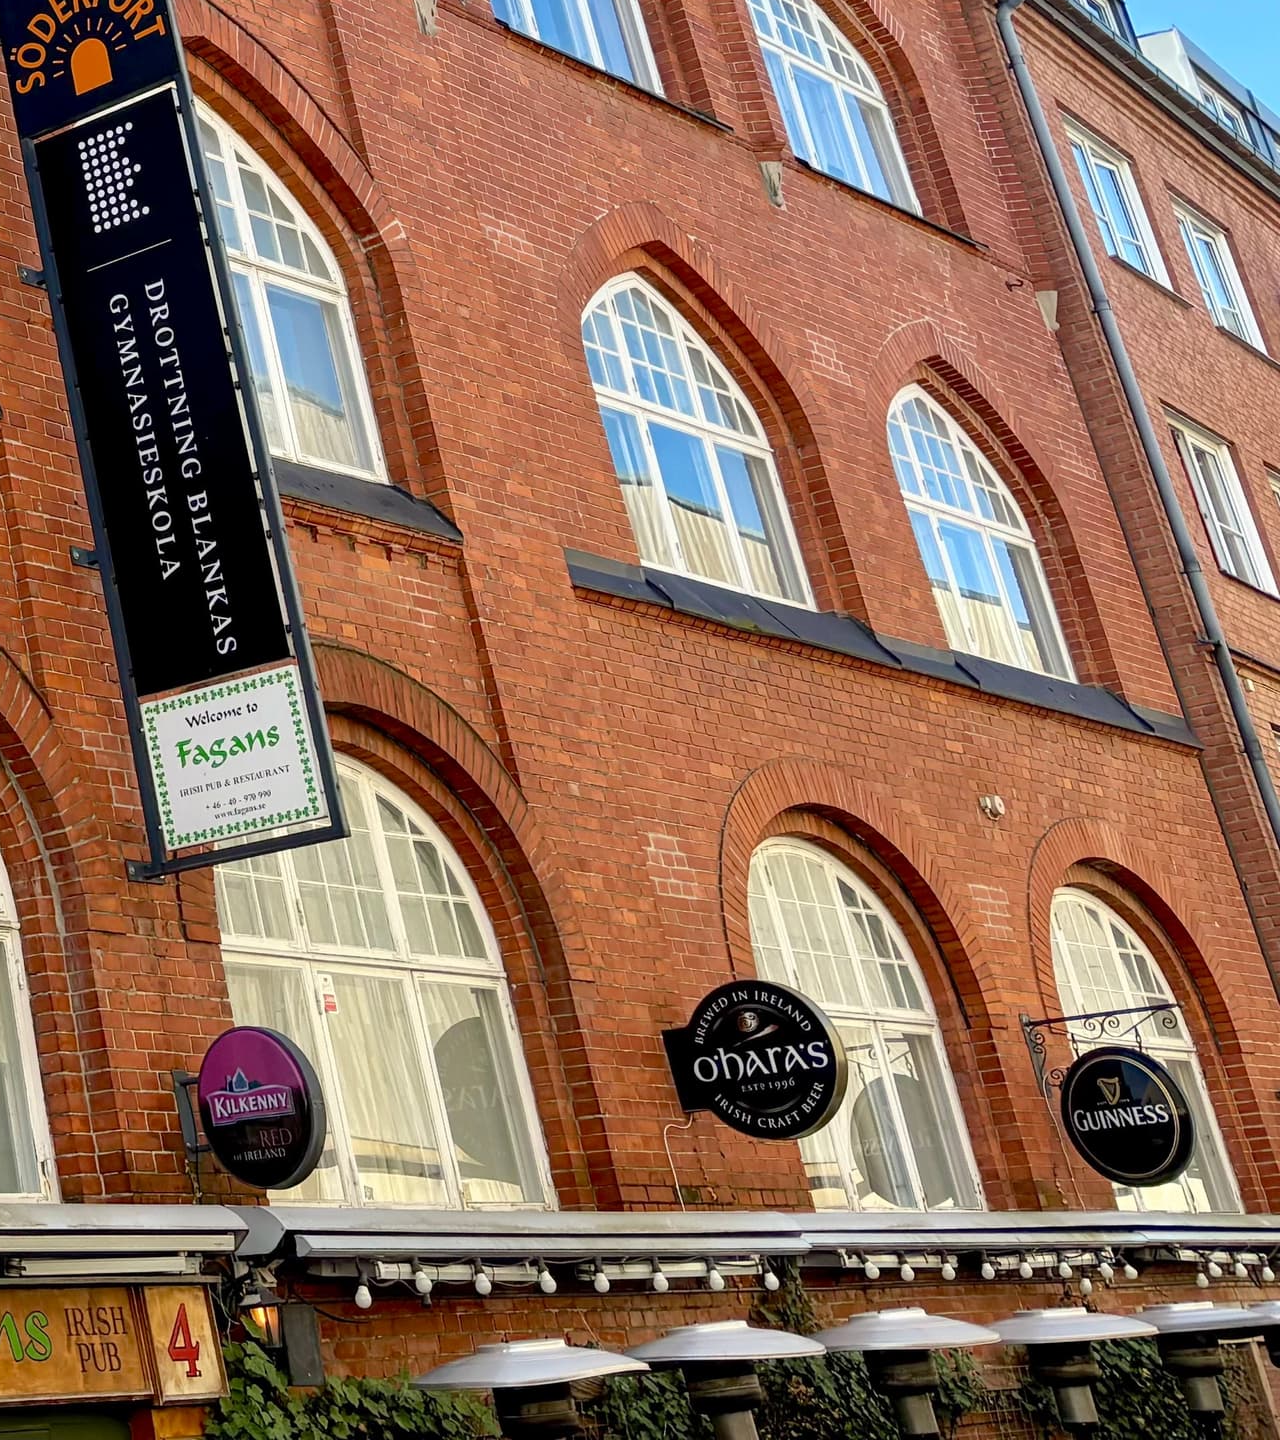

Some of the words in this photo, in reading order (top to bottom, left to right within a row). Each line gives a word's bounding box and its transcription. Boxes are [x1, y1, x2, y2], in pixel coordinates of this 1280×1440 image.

[109, 293, 182, 581] GYMNASIESKOLA
[144, 277, 203, 481] DROTTNING
[186, 489, 238, 656] BLANKAS
[184, 706, 243, 729] Welcome
[245, 702, 259, 714] to
[175, 725, 281, 769] Fagans
[179, 783, 204, 798] IRISH
[205, 779, 223, 792] PUB
[224, 778, 231, 788] &
[233, 764, 291, 786] RESTAURANT
[214, 803, 267, 820] www.fagans.se
[694, 996, 729, 1045] BREWED
[731, 990, 749, 1003] IN
[754, 990, 812, 1033] IRELAND
[768, 1076, 796, 1092] 1996
[213, 1091, 288, 1119] KILKENNY
[714, 1093, 752, 1125] IRISH
[757, 1110, 801, 1129] CRAFT
[800, 1081, 825, 1114] BEER
[1073, 1103, 1170, 1132] GUINNESS
[243, 1147, 287, 1161] IRELAND
[258, 1127, 293, 1148] RED
[63, 1305, 128, 1338] IRISH
[167, 1302, 203, 1379] 4
[77, 1341, 122, 1374] PUB
